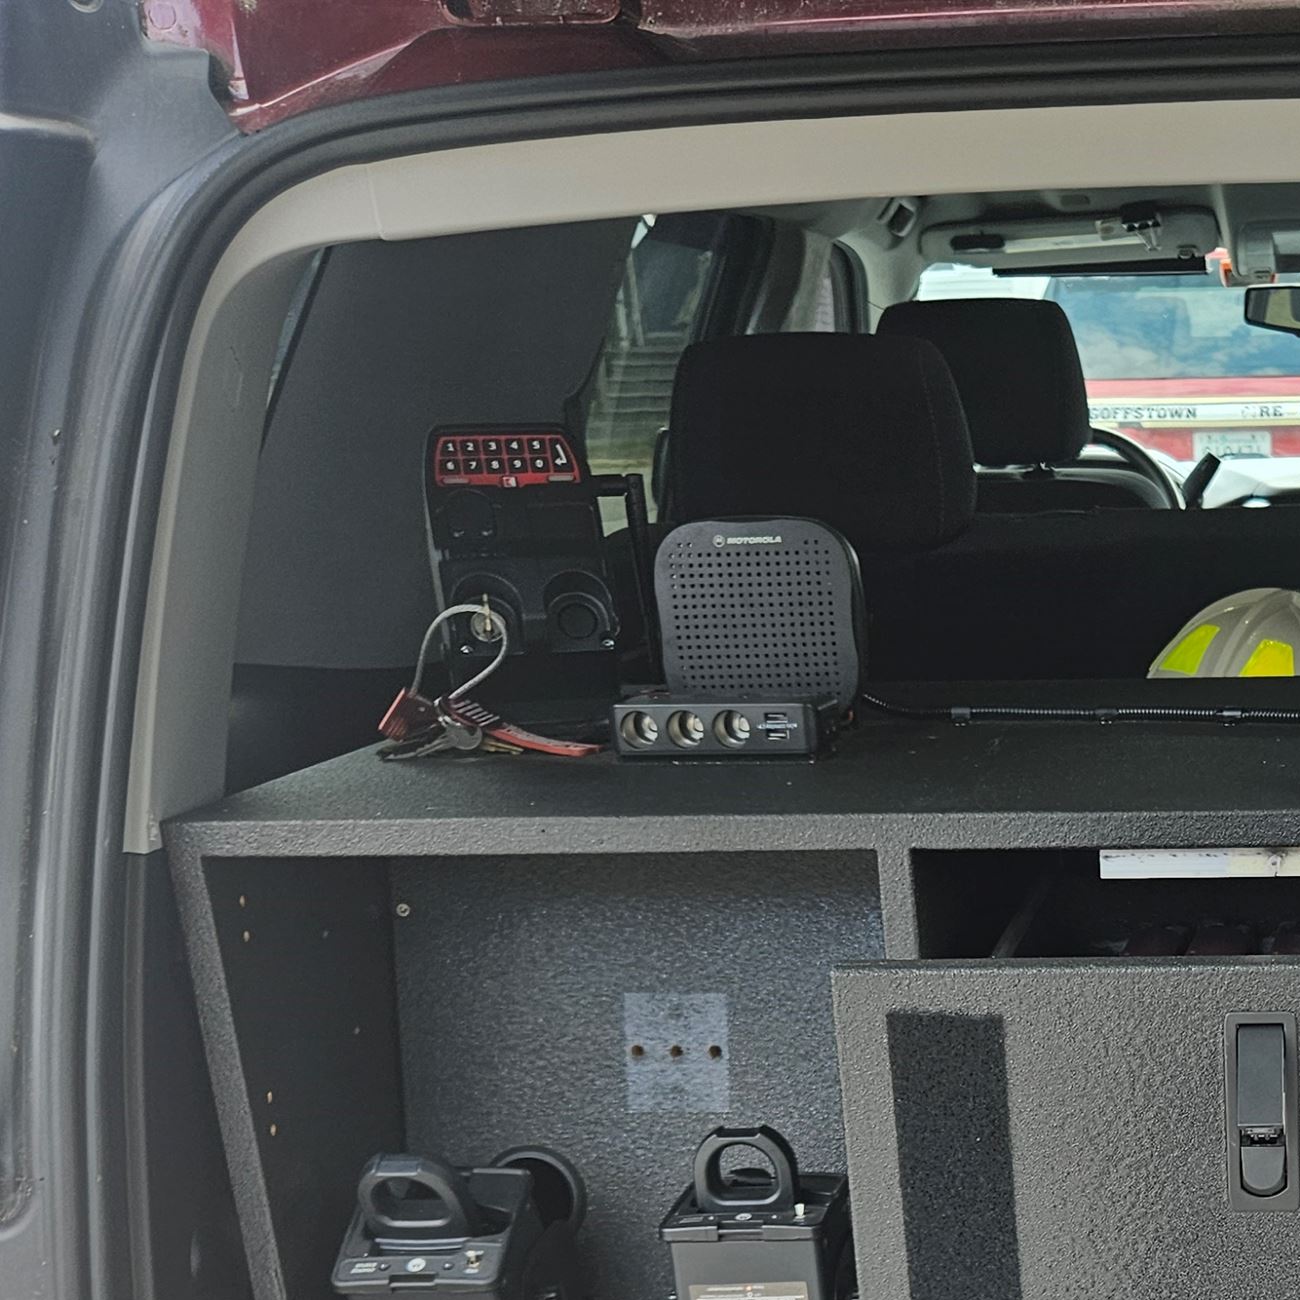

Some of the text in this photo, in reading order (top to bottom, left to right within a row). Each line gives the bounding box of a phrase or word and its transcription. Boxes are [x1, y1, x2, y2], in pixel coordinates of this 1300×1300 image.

[448, 443, 454, 451] 1
[533, 441, 540, 449] 5
[446, 461, 454, 469] 6
[470, 461, 477, 469] 7
[491, 461, 499, 469] 8
[514, 460, 521, 468] 9
[727, 536, 782, 544] MOTOROLA
